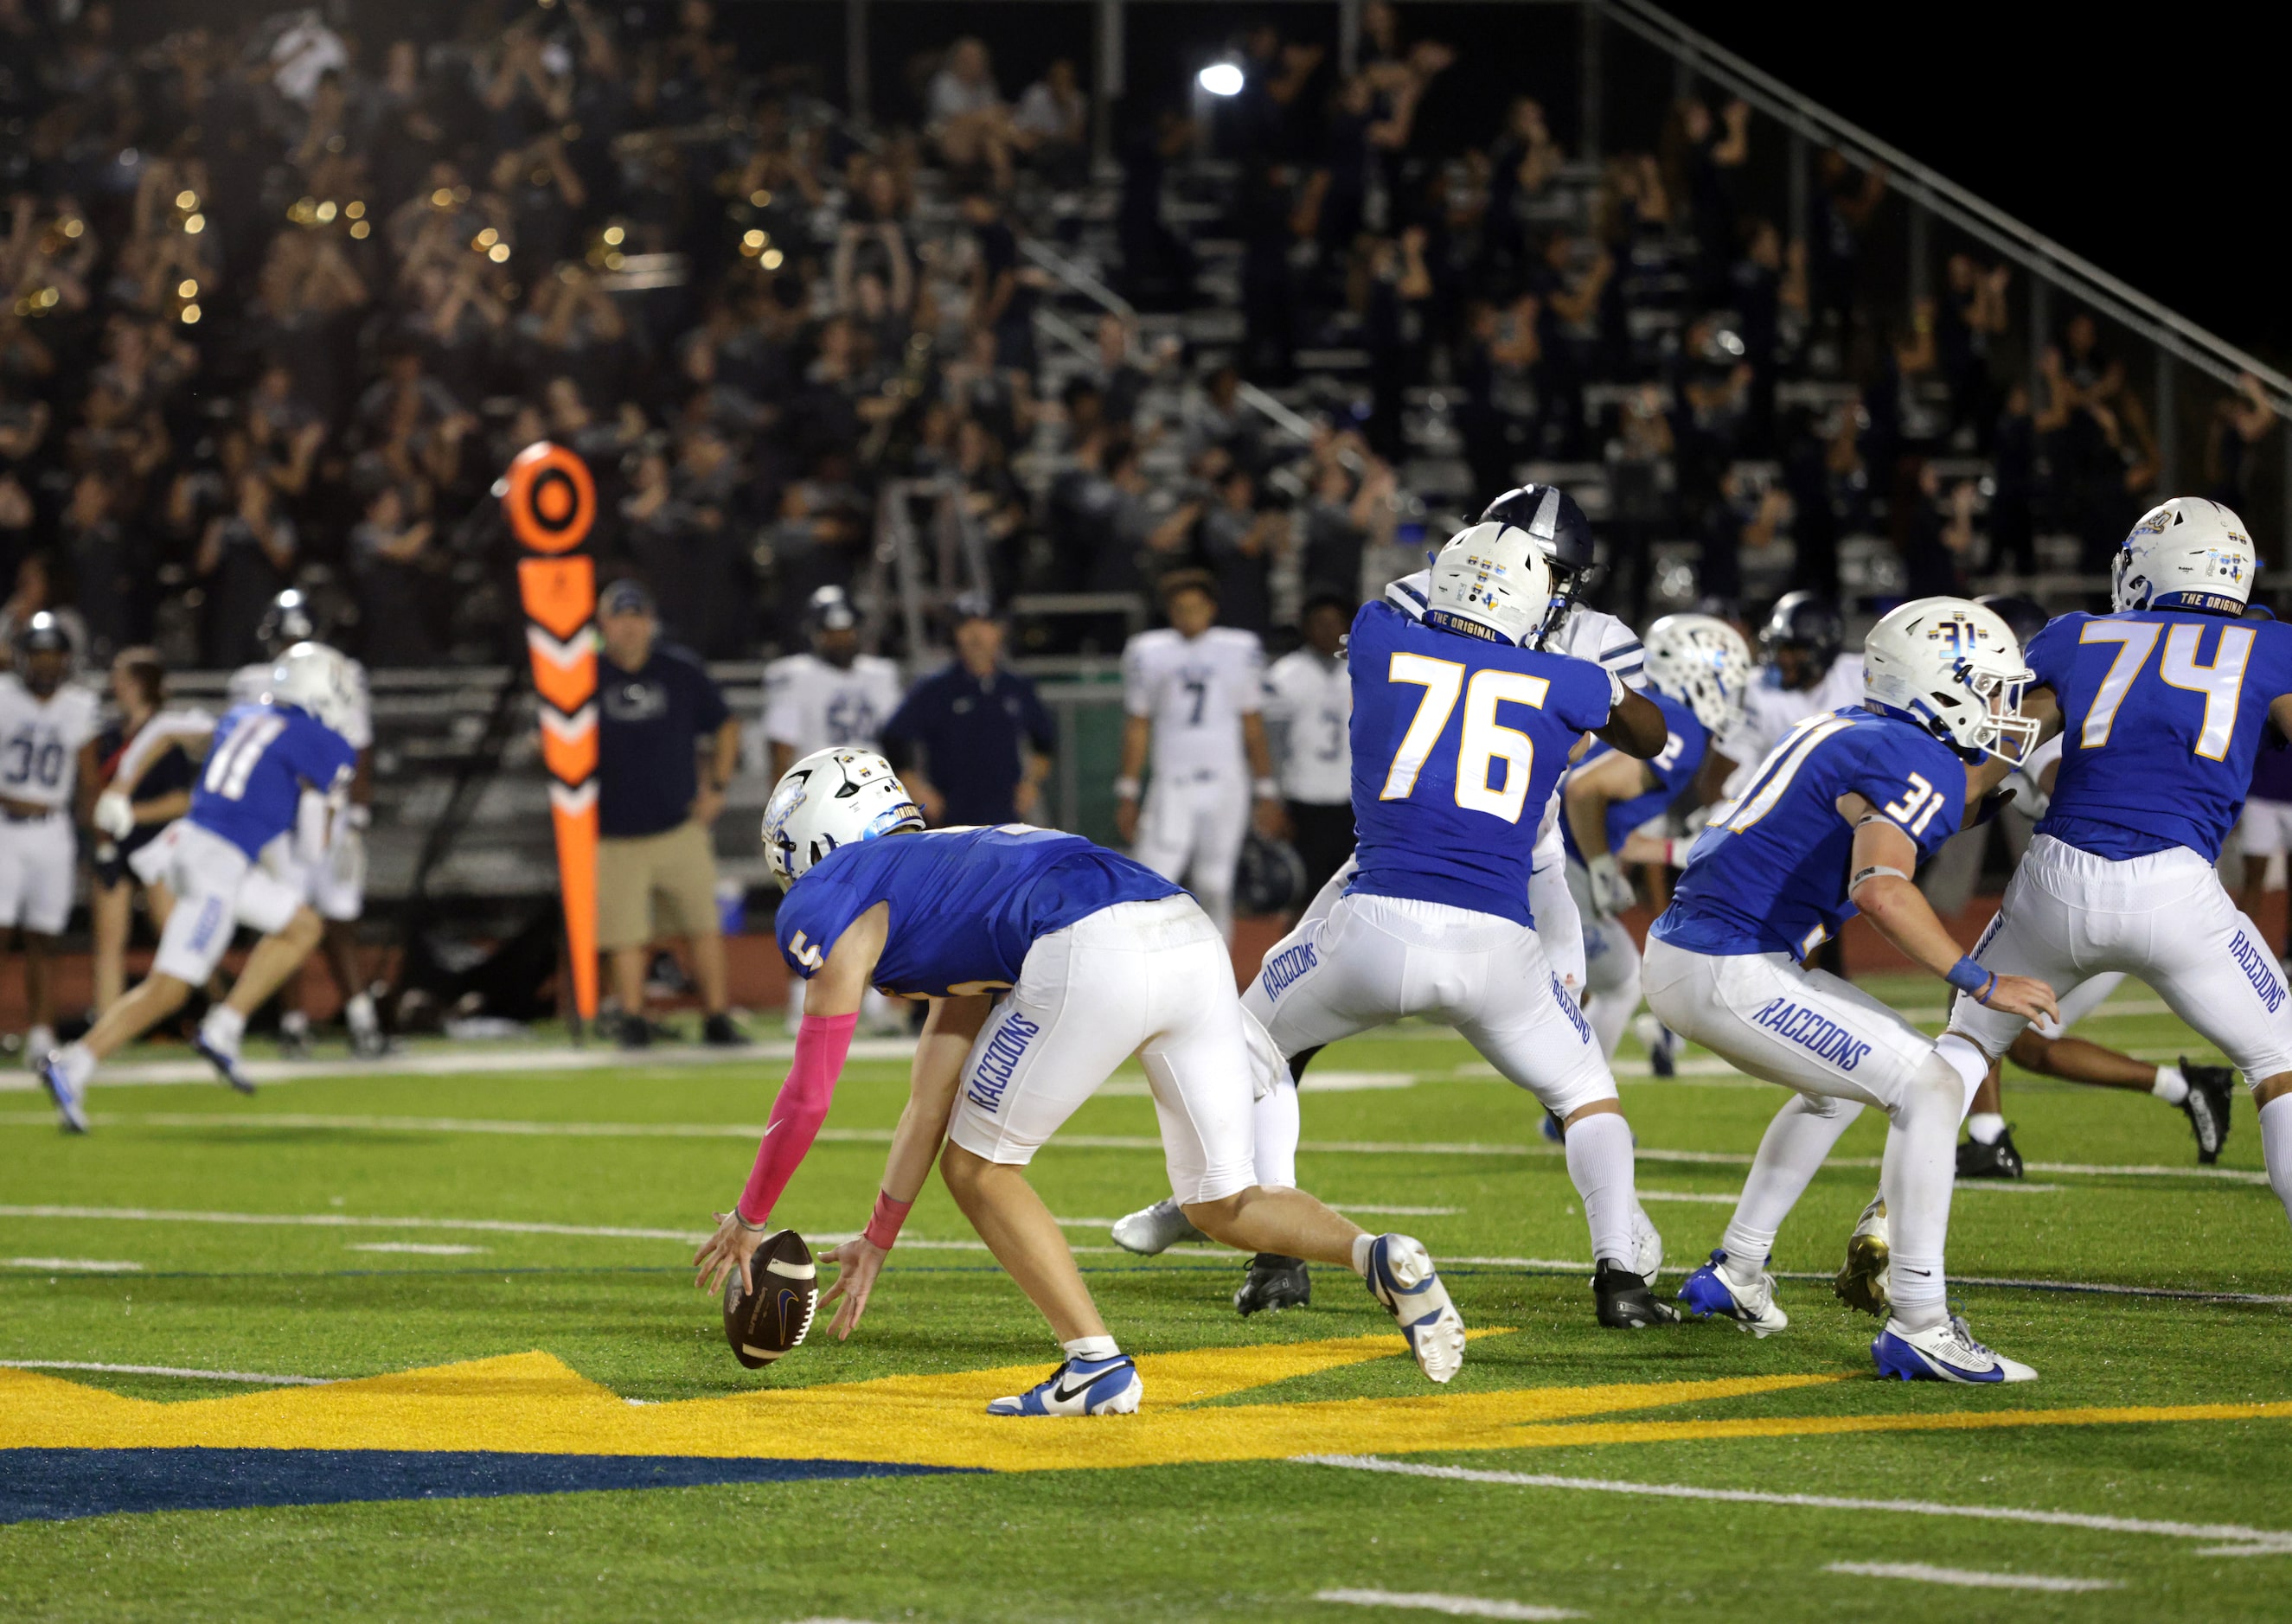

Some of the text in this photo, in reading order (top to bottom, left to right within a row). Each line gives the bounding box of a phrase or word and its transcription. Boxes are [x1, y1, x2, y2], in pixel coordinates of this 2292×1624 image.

[1432, 611, 1450, 625] THE
[1450, 613, 1497, 643] ORIGINAL
[2180, 591, 2244, 617] THE ORIGINAL
[1938, 622, 1976, 660] 31
[2079, 620, 2257, 763] 74
[203, 713, 288, 802] 11
[1380, 652, 1551, 825] 76
[1884, 771, 1946, 838] 31
[788, 929, 824, 972] 5
[1262, 942, 1317, 1003] RACCOONS
[2228, 929, 2286, 1014] RACCOONS
[968, 1012, 1040, 1114] RACCOONS
[1751, 997, 1873, 1072] RACCOONS
